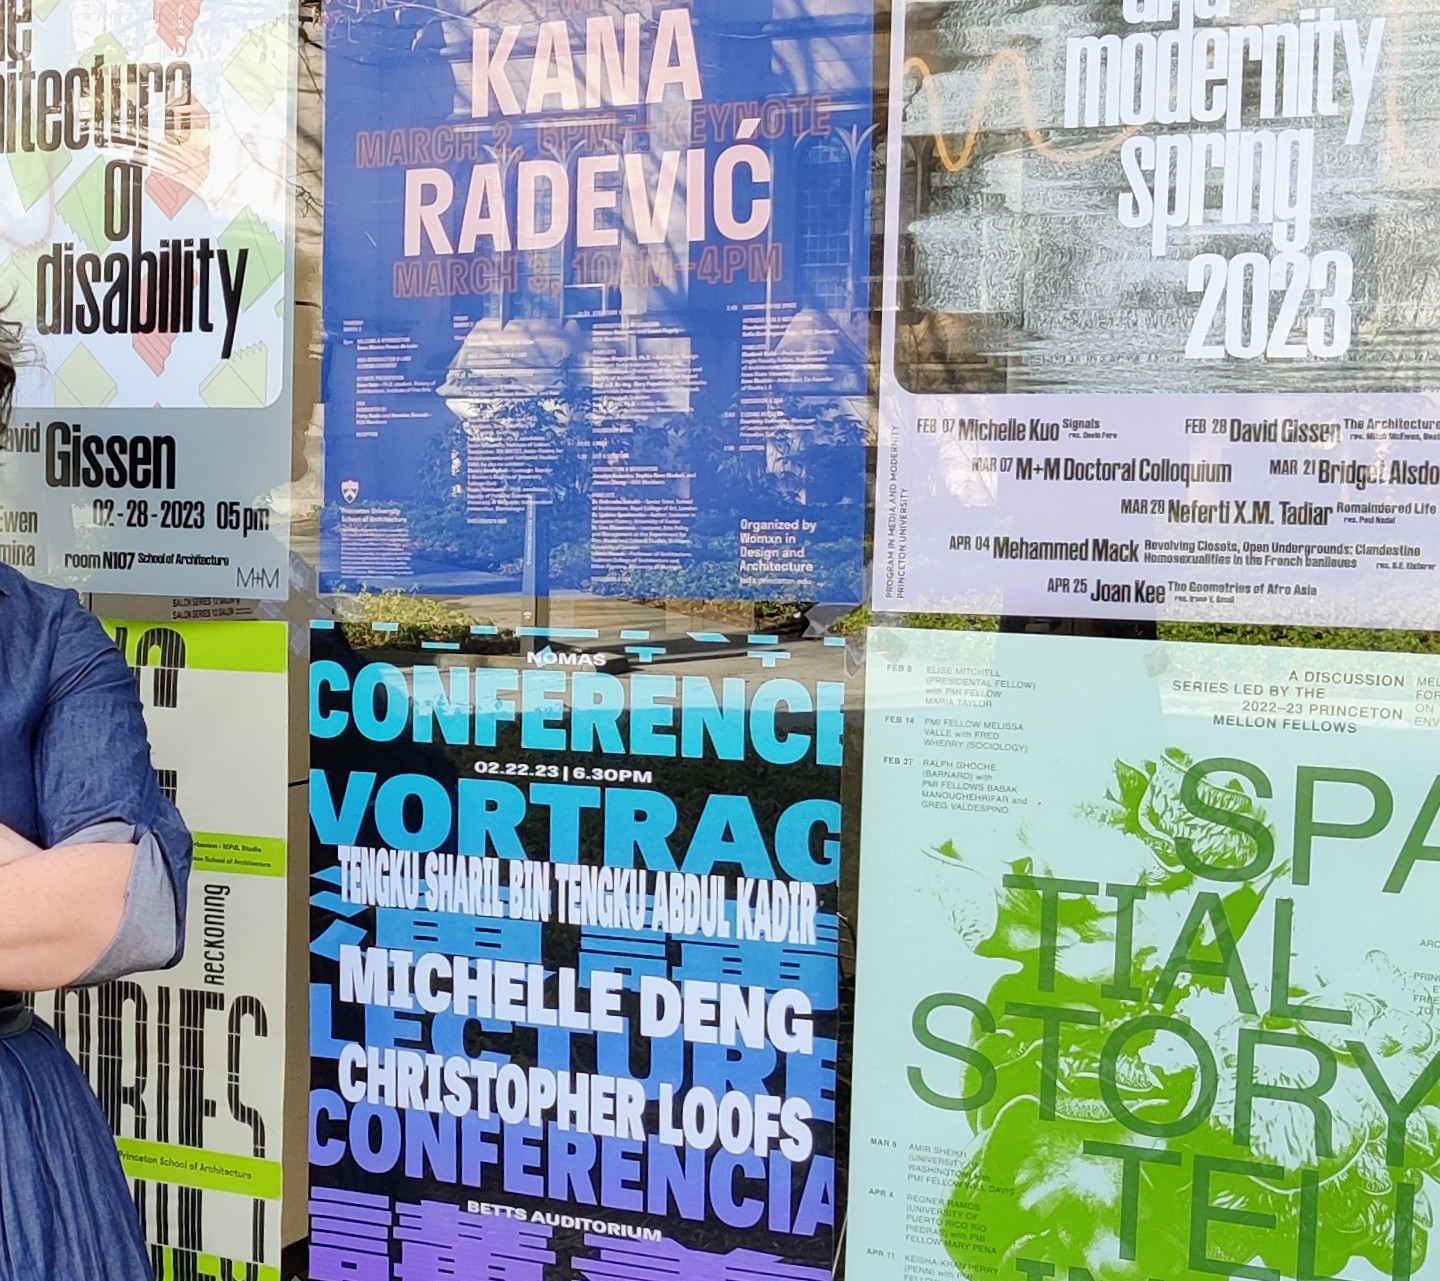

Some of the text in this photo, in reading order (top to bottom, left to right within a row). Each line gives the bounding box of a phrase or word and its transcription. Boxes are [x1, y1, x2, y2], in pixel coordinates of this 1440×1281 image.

[471, 8, 703, 118] KANA
[1064, 8, 1386, 145] modernity
[356, 126, 478, 169] MARCH
[662, 95, 833, 148] KEYNOTE
[105, 158, 145, 243] of
[403, 118, 771, 257] RADEVIĆ
[1117, 127, 1314, 257] spring
[393, 257, 518, 299] MARCH
[37, 237, 248, 359] disability
[1184, 251, 1354, 360] 2023
[917, 418, 1101, 442] FEB 07 Michelle Kuo Signals
[1185, 419, 1206, 434] FEB
[1212, 419, 1227, 434] 28
[1230, 419, 1277, 442] David
[1282, 419, 1341, 443] Gissen
[1343, 419, 1364, 430] The
[6, 421, 176, 489] avid Gissen
[971, 458, 1232, 488] MAR 07 M+M Doctoral Colloquium
[1270, 460, 1297, 475] MAR
[1303, 460, 1316, 475] 21
[1318, 460, 1386, 490] Bridget
[889, 483, 897, 506] AND
[740, 519, 817, 533] Organized by
[888, 507, 896, 537] MEDIA
[1121, 499, 1147, 514] MAR
[1150, 499, 1165, 514] 28
[1168, 500, 1230, 524] Neferti
[1234, 500, 1274, 524] X.M.
[1279, 501, 1333, 525] Tadiar
[1414, 503, 1436, 514] Life
[740, 547, 805, 559] Design and
[785, 533, 796, 543] in
[897, 488, 908, 598] PRINCETON UNIVERSITY
[949, 536, 971, 550] APR
[975, 536, 990, 551] 04
[993, 537, 1088, 561] Mehammed
[1092, 538, 1139, 562] Mack
[1144, 540, 1195, 553] Revolving
[1243, 541, 1269, 557] Open
[1355, 544, 1421, 556] Clandestine
[65, 551, 230, 570] room N107 School of Architecture
[740, 560, 814, 572] Architecture
[886, 549, 895, 598] PROGRAM
[1233, 554, 1243, 565] in
[1246, 555, 1262, 565] the
[1265, 555, 1302, 567] French
[236, 567, 279, 588] M+M
[1047, 578, 1070, 593] APR
[1073, 578, 1087, 593] 25
[1091, 579, 1130, 602] Joan
[1135, 580, 1165, 603] Kee
[1168, 581, 1187, 592] The
[1253, 583, 1264, 594] of
[1267, 584, 1291, 595] Afro
[1294, 584, 1317, 595] Asia
[527, 650, 606, 667] NOMAS
[1172, 680, 1325, 699] SERIES LED BY THE
[1288, 671, 1404, 687] A DISCUSSION
[944, 719, 981, 728] FELLOW
[984, 721, 1024, 731] MELISSA
[1213, 715, 1357, 733] MELLON FELLOWS
[1309, 704, 1403, 720] PRINCETON
[924, 728, 951, 737] VALLE
[975, 731, 999, 740] FRED
[474, 761, 652, 784] 02.22.23 6.30PM
[309, 769, 842, 885] VORTRAG
[338, 845, 420, 911] TENGKU
[425, 851, 505, 918] SHARIL
[508, 857, 551, 923] BIN
[554, 863, 647, 932] TENGKU
[652, 871, 731, 941] ABDUL
[736, 877, 817, 946] KADIR
[1002, 873, 1353, 1026] TIAL
[338, 946, 814, 1055] MICHELLE DENG
[907, 992, 1440, 1168] STORY
[338, 1043, 813, 1163] CHRISTOPHER LOOFS
[467, 1200, 662, 1243] BETTS AUDITORIUM
